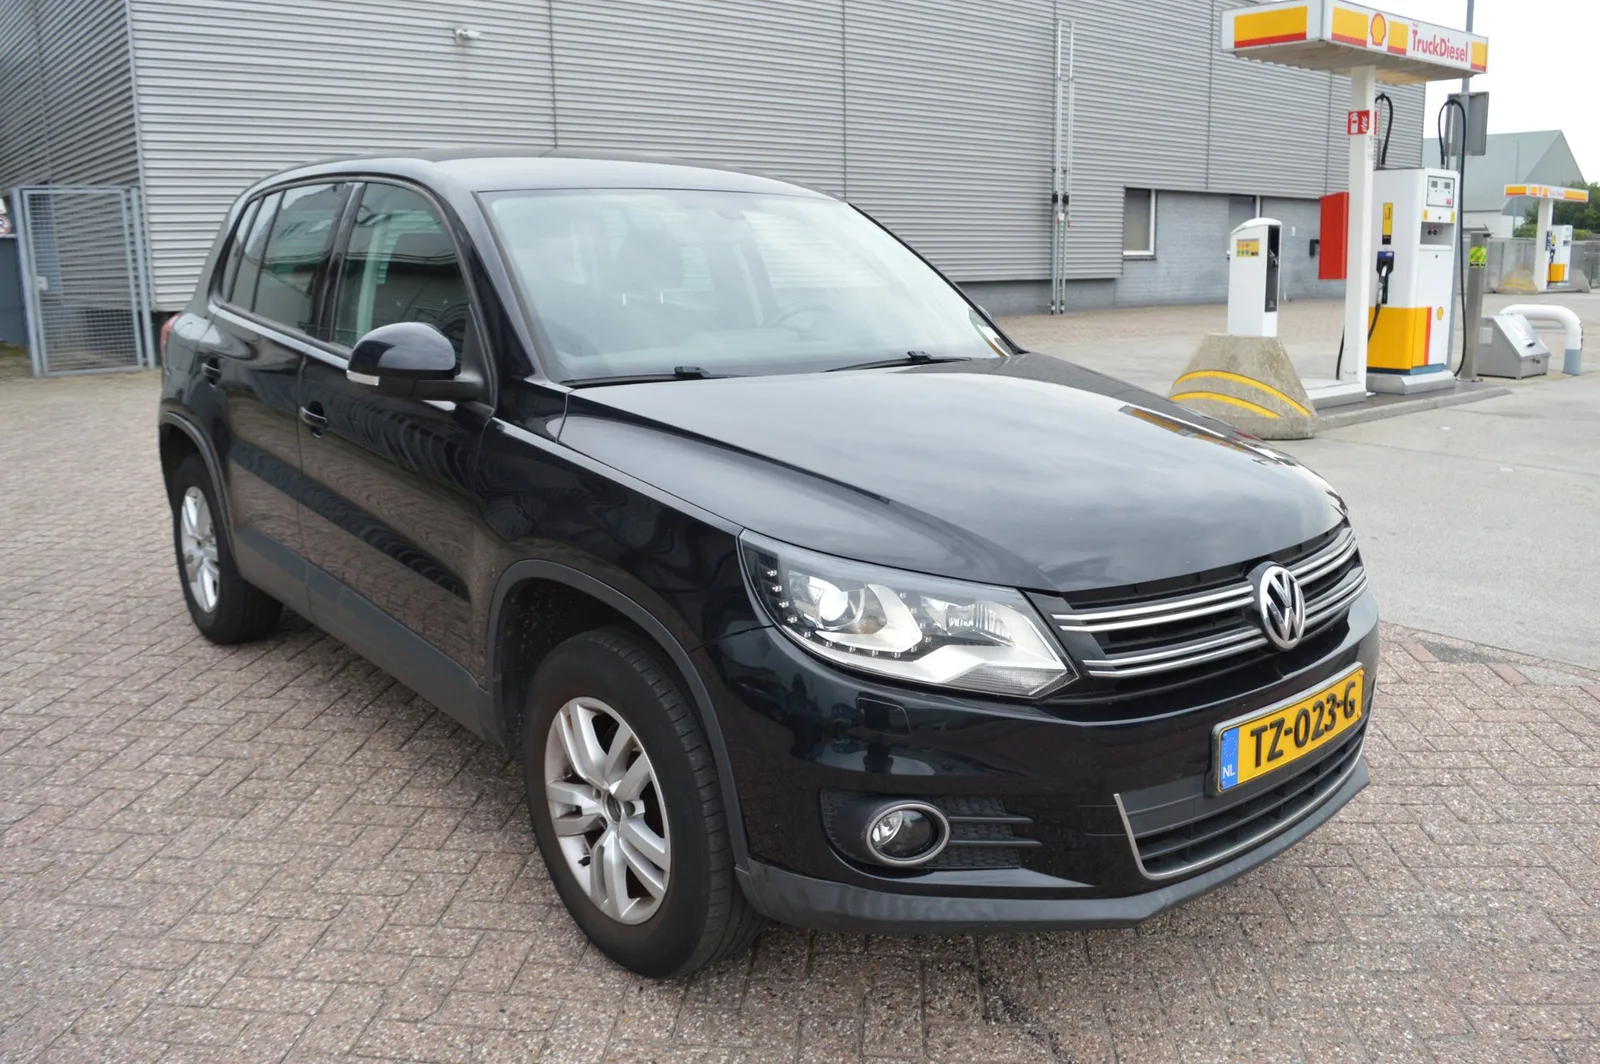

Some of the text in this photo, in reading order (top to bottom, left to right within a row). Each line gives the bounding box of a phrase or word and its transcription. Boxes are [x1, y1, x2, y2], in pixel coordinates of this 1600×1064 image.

[1412, 29, 1469, 63] TruckDiesel
[1260, 566, 1306, 649] VW
[1250, 681, 1356, 767] TZ-023-G
[1222, 764, 1236, 779] NL
